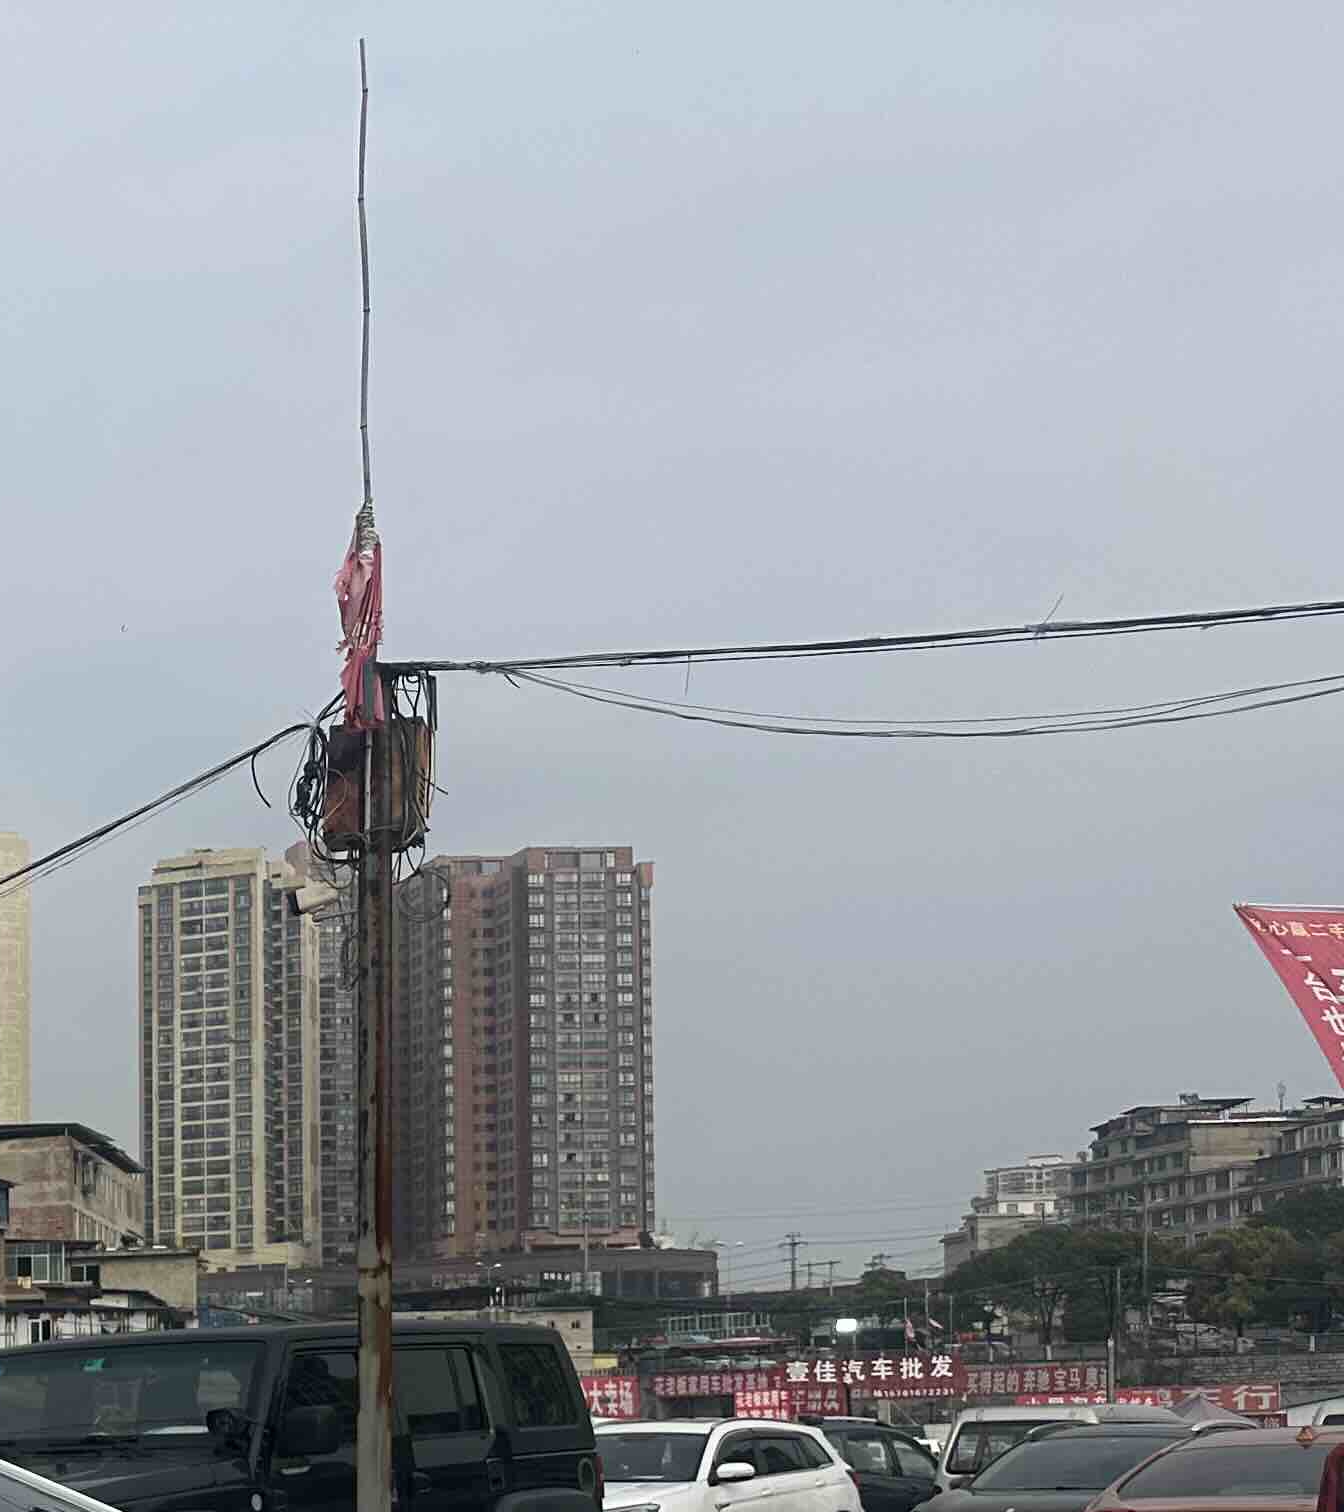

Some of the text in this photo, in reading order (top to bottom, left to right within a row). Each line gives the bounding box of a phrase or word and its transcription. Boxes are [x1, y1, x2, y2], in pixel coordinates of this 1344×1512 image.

[786, 1355, 954, 1384] 壹佳汽车批发
[580, 1379, 633, 1416] 大卖场
